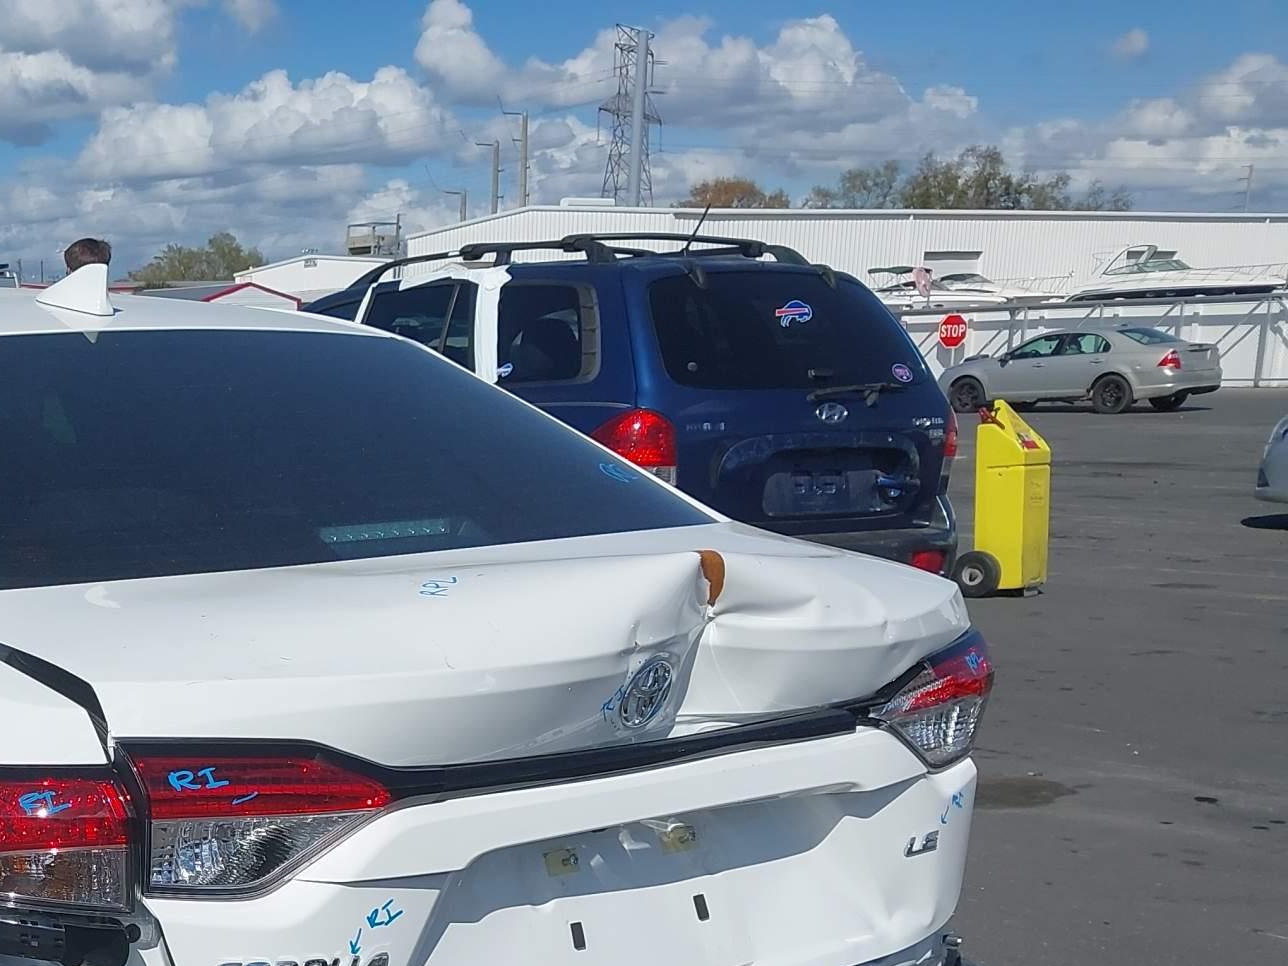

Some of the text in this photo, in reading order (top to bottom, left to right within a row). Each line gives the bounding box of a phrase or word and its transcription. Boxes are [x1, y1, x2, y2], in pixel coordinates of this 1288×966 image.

[940, 324, 966, 338] STOP
[167, 767, 229, 791] RI
[904, 829, 939, 857] LE
[366, 898, 403, 928] RI
